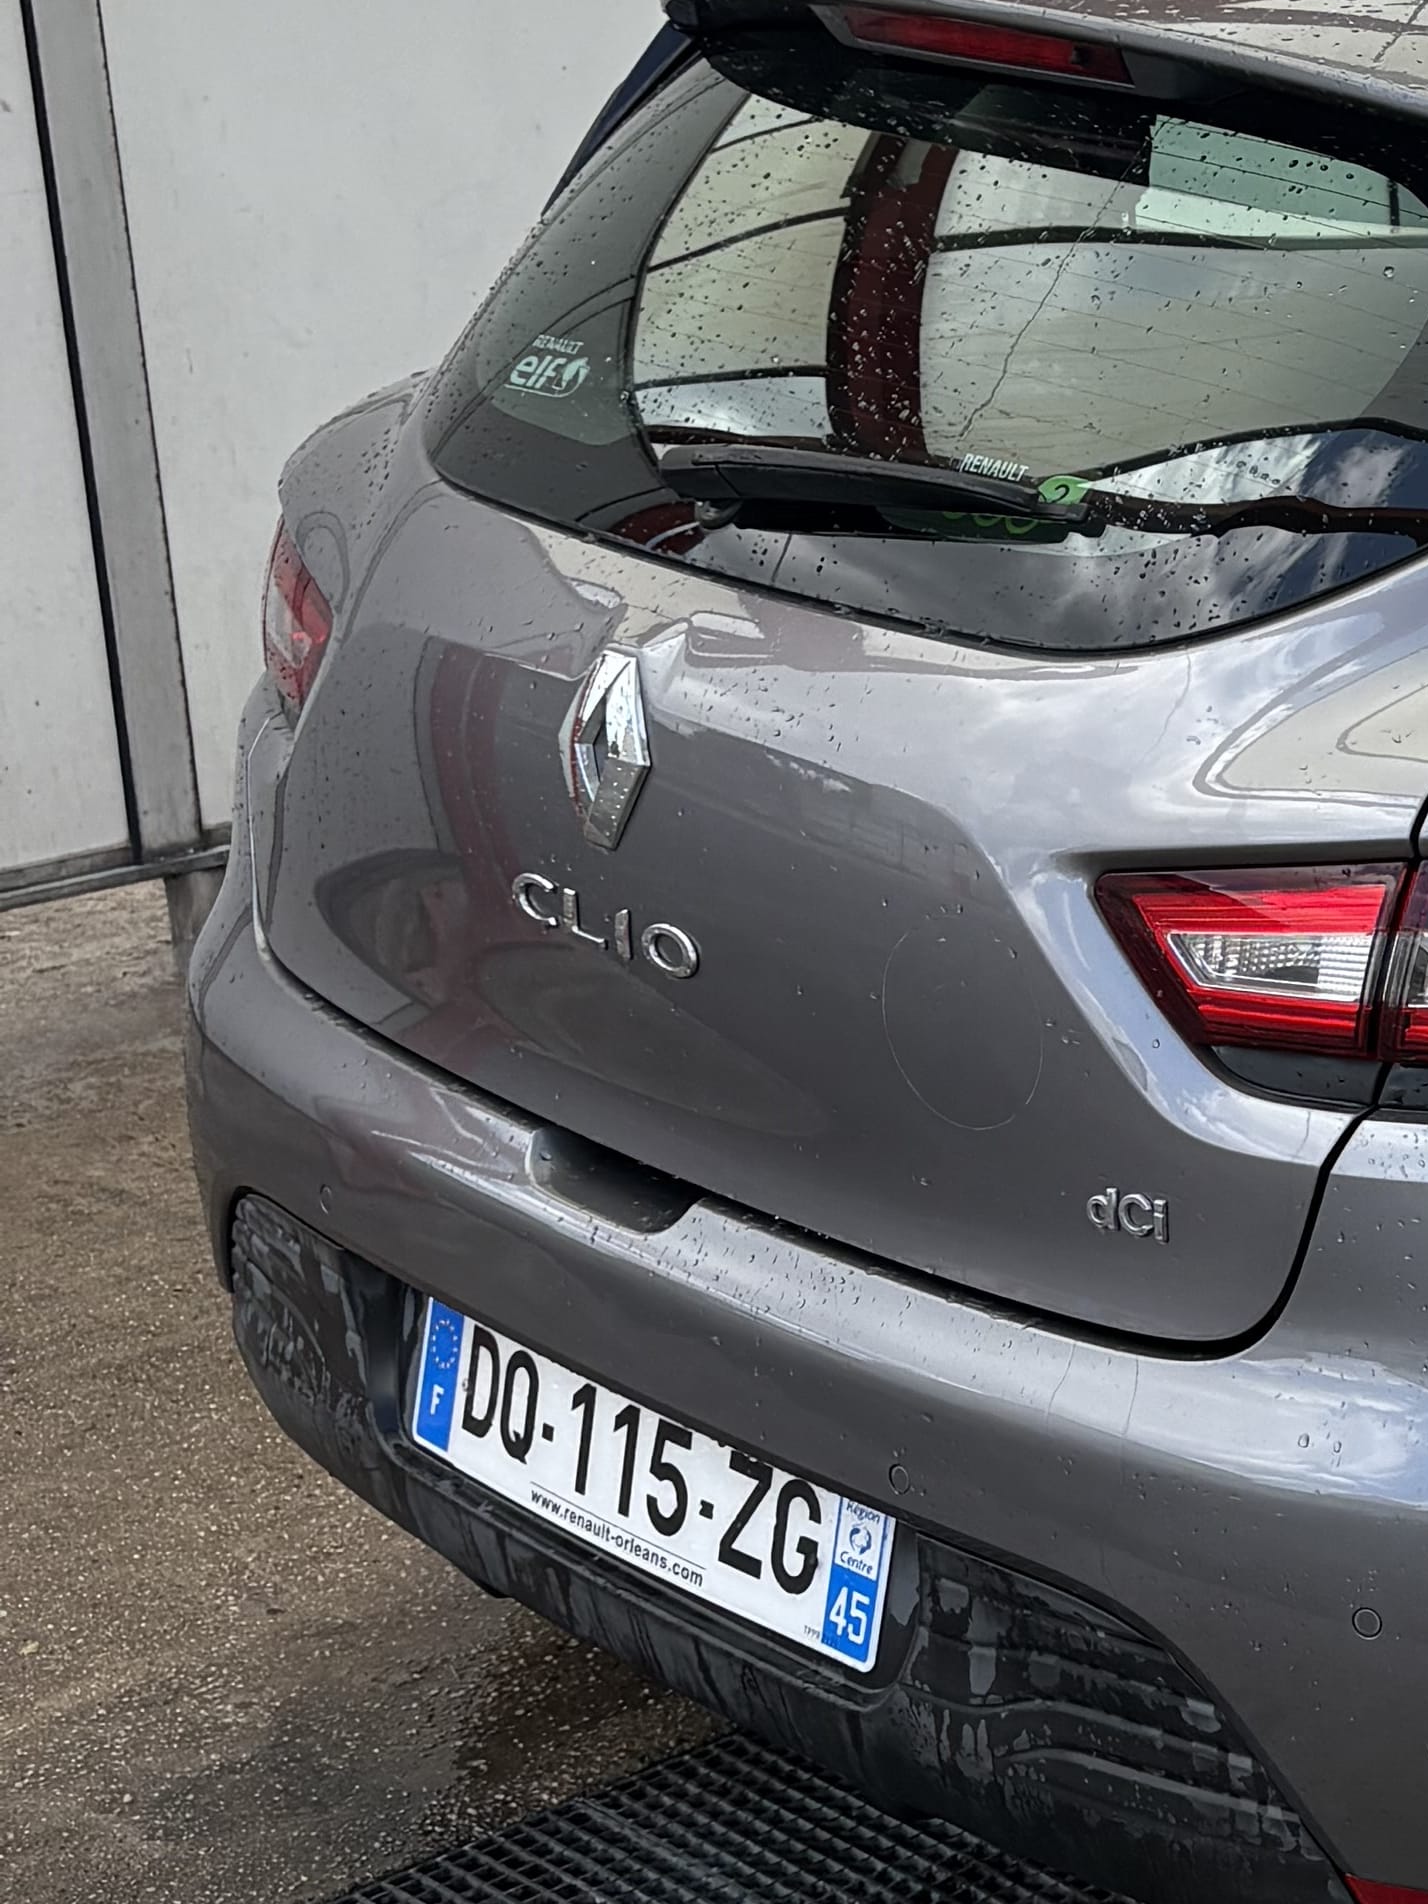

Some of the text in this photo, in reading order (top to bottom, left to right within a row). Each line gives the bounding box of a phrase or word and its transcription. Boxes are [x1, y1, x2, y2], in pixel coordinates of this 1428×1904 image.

[532, 334, 585, 355] RENAULT
[510, 355, 568, 390] elf
[959, 452, 1030, 483] RENAULT
[511, 872, 702, 980] CLIO
[429, 1385, 445, 1417] F
[461, 1324, 822, 1596] DQ-115-ZG
[530, 1489, 704, 1588] www.renault-orleans.com
[840, 1550, 873, 1575] Centre
[829, 1586, 870, 1646] 45
